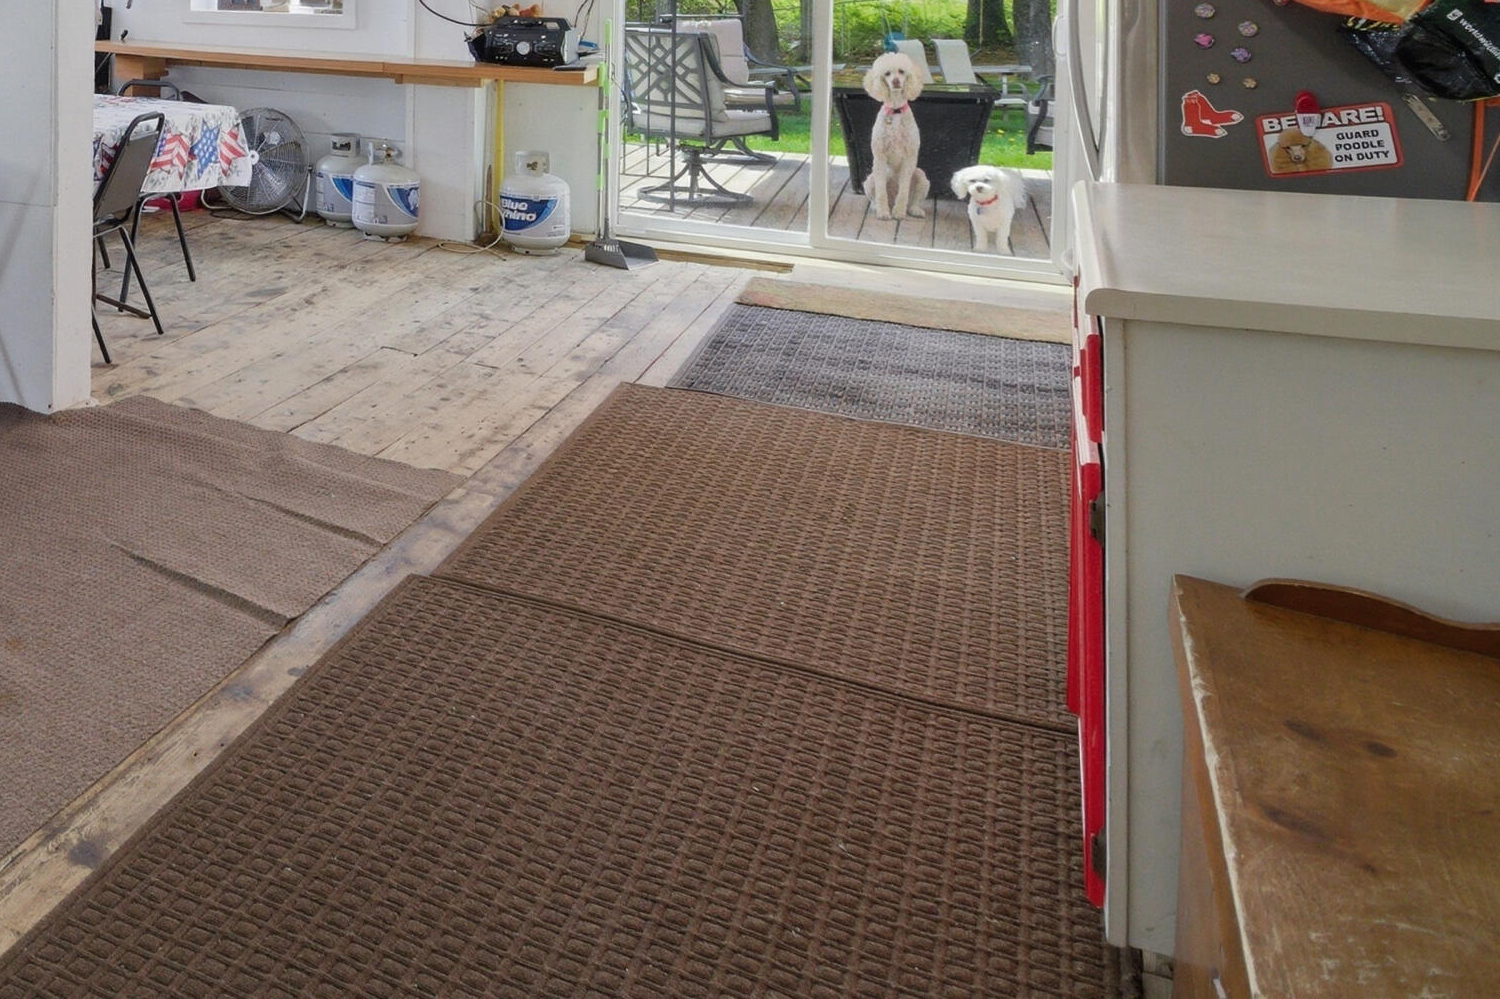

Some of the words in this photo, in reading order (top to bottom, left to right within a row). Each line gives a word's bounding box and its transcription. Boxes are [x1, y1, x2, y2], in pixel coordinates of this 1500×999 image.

[1261, 106, 1386, 134] BEARE!
[1335, 129, 1380, 140] GUARD
[1334, 139, 1386, 151] POODLE
[1334, 153, 1354, 163] ON
[1356, 150, 1390, 161] DUTY
[501, 198, 529, 211] Blue
[503, 209, 538, 222] hino
